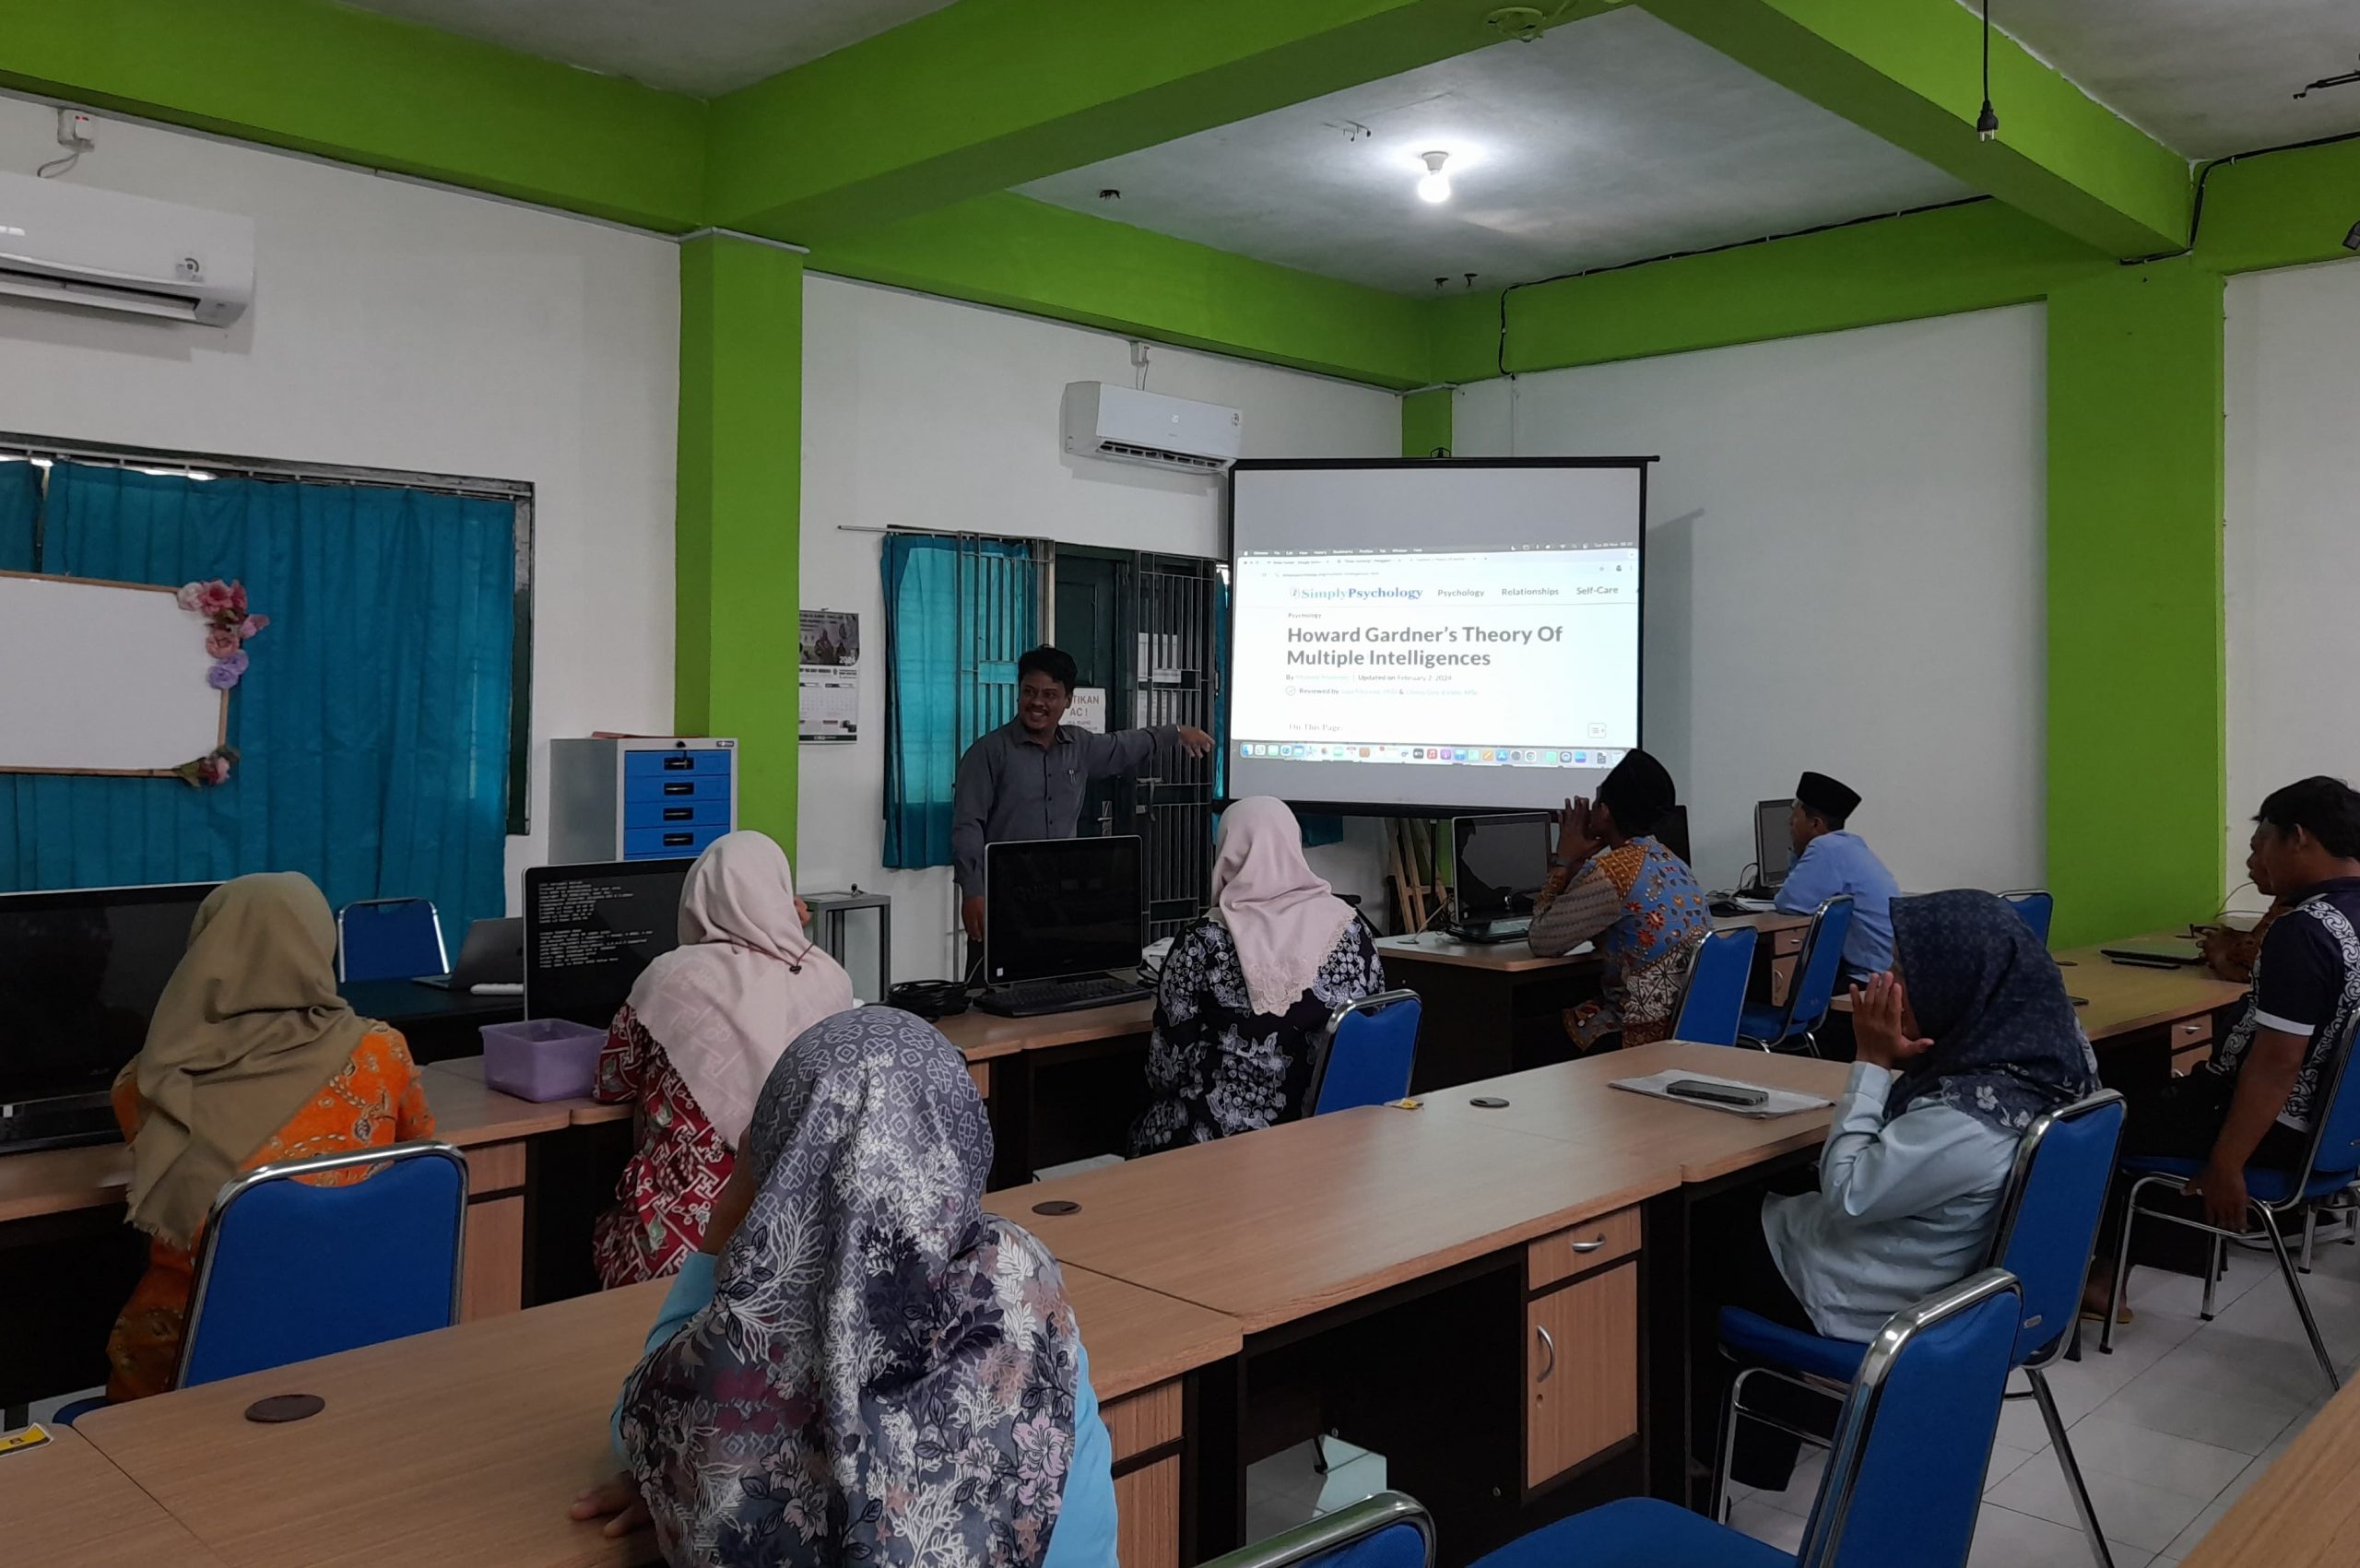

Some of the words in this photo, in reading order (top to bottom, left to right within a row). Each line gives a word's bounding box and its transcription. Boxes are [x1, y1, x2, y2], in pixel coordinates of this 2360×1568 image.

[1301, 587, 1423, 600] SimplyPsychology
[1438, 589, 1485, 597] Psychology
[1502, 587, 1559, 596] Relationships
[1576, 585, 1619, 595] Self-Care
[1288, 627, 1361, 643] Howard
[1365, 626, 1457, 643] Gardner’s
[1462, 626, 1533, 645] Theory
[1538, 626, 1564, 643] Of
[1287, 650, 1364, 668] Multiple
[1370, 650, 1491, 669] Intelligences
[1358, 674, 1386, 682] Updated
[1074, 695, 1100, 705] TIKAN
[1070, 707, 1083, 717] AC
